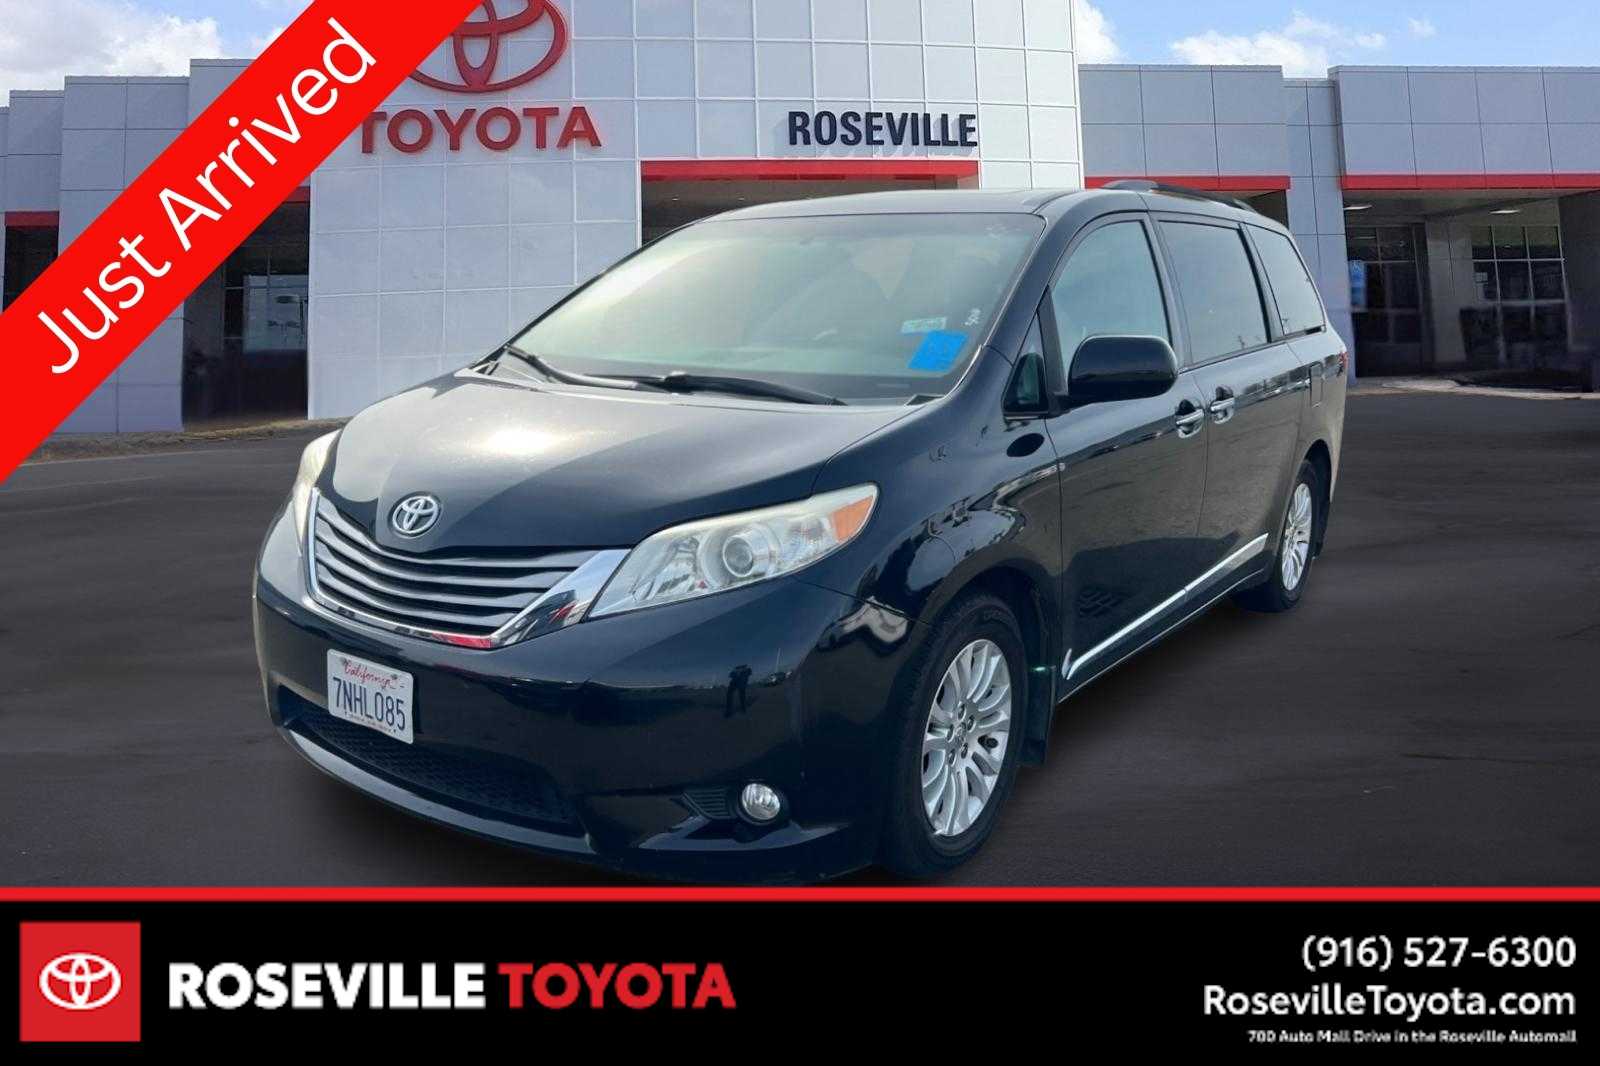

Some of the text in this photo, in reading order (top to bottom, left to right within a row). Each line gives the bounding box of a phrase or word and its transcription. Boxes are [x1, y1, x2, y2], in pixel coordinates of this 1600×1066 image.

[361, 106, 602, 154] TOYOTA
[788, 110, 978, 147] ROSEVILLE
[332, 676, 406, 731] 7NHL085
